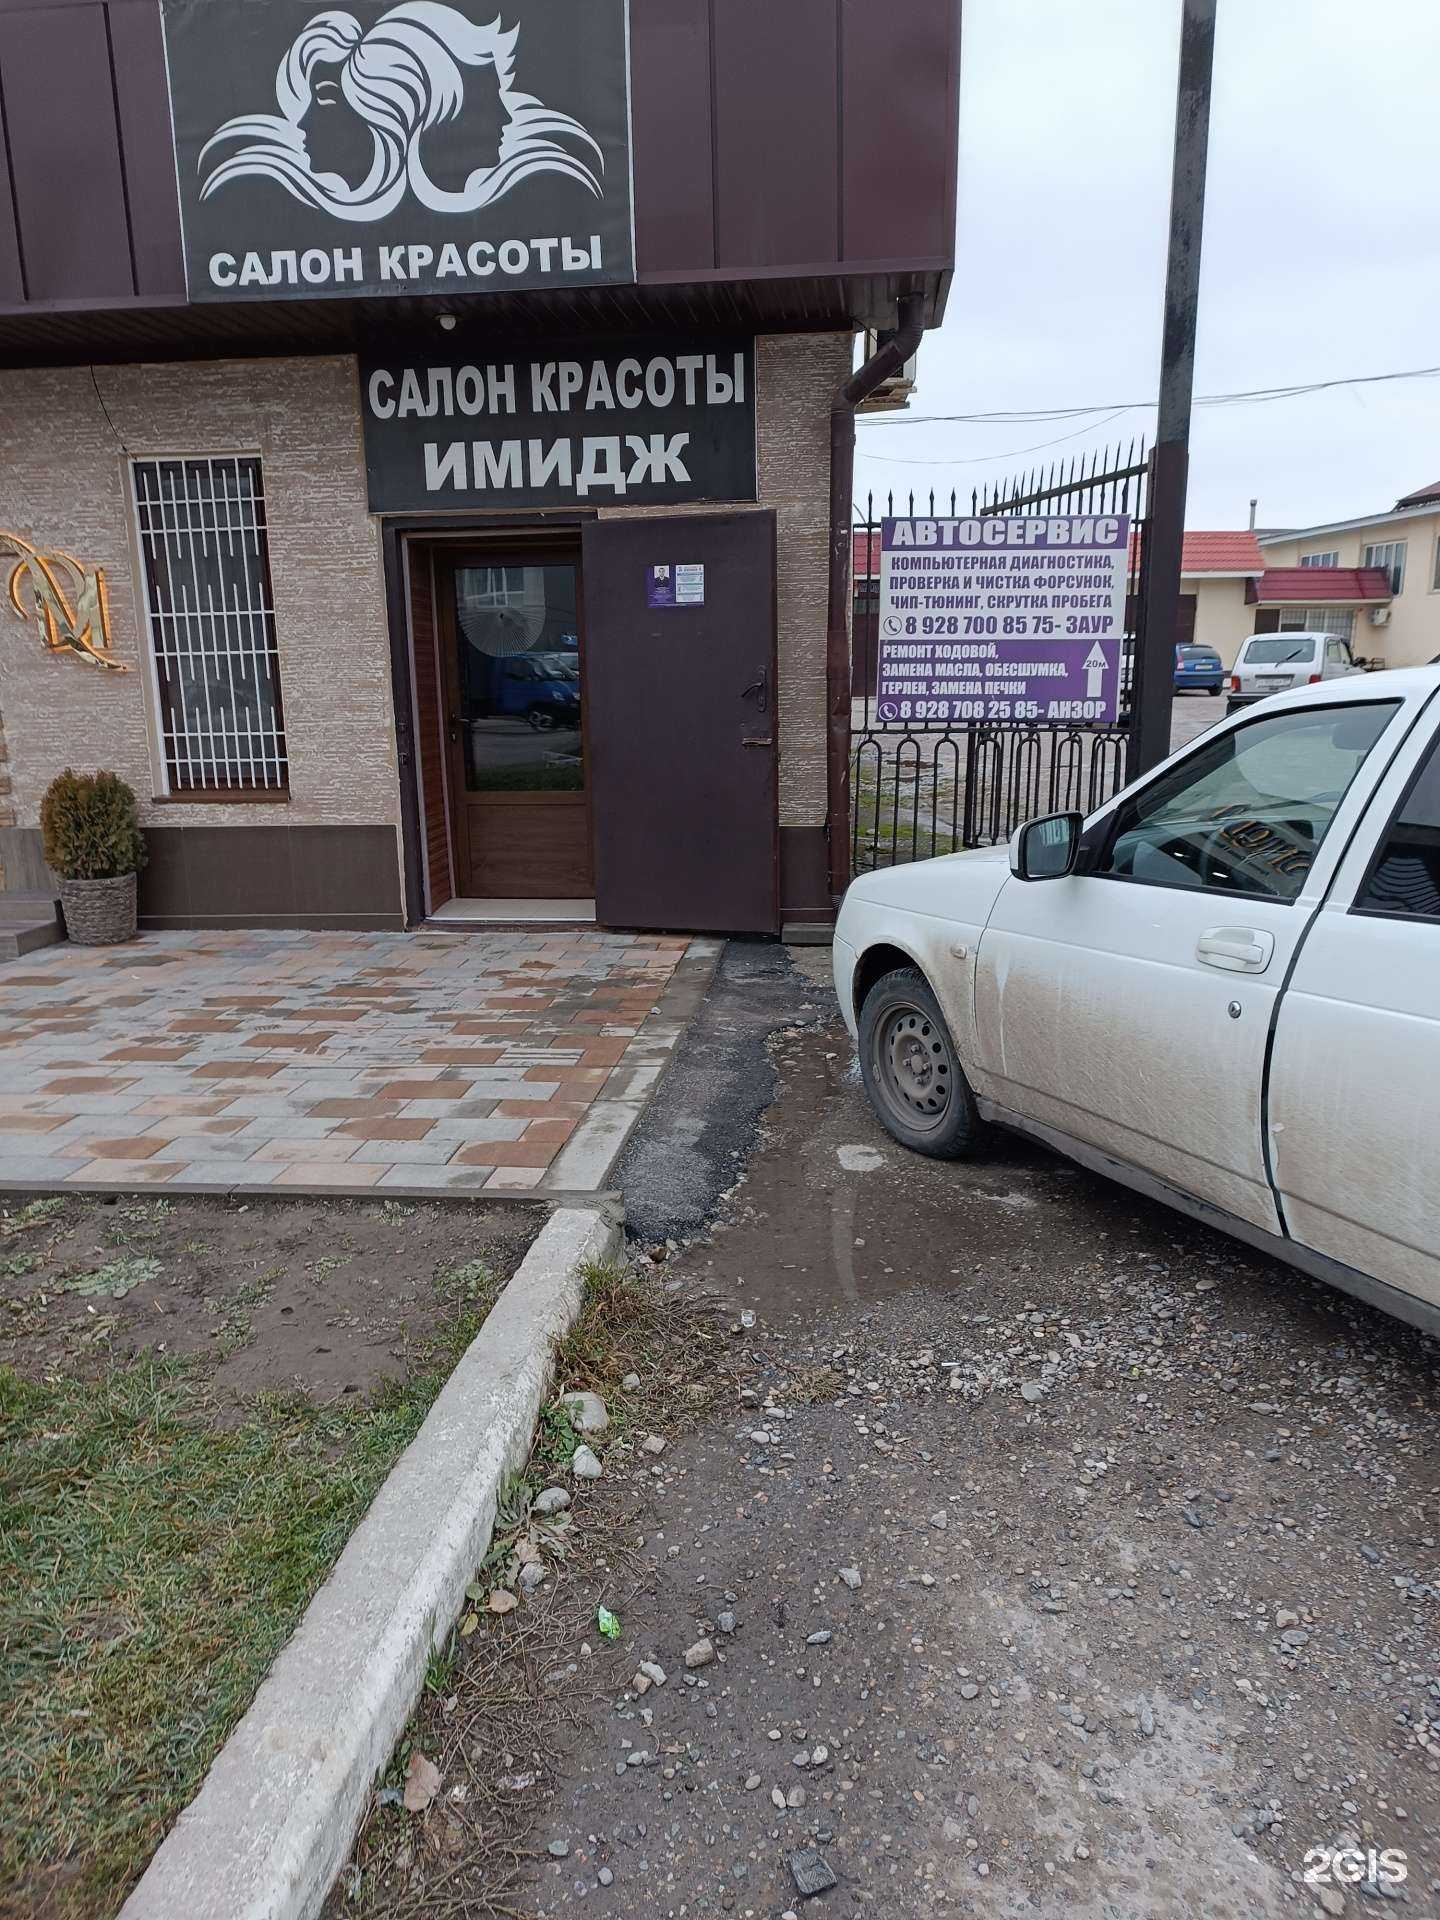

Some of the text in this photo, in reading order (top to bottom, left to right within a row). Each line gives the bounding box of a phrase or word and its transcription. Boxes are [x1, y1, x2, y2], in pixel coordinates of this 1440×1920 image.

[208, 234, 603, 288] САЛОН КРАСОТЫ
[368, 352, 745, 420] САЛОН КРАСОТЫ
[423, 432, 692, 497] ИМИДЖ
[891, 517, 1119, 546] АВТОСЕРВИС
[891, 555, 1115, 572] КОМПЬЮТЕРНАЯ ДИАГНОСТИКА,
[889, 574, 1115, 590] ПРОВЕРКА И ЧИСТКА ФОРСУНОК,
[890, 594, 1112, 610] ЧИП-ТЮНИНГ, СКРУТКА ПРОБЕГА
[905, 615, 917, 635] 8
[922, 615, 959, 635] 928
[963, 615, 998, 635] 700
[1002, 615, 1028, 634] 85
[1065, 614, 1114, 634] ЗАУР
[882, 641, 999, 660] РЕМОНТ ХОДОВОЙ,
[882, 662, 1069, 678] ЗАМЕНА МАСЛА, ОБЕСШУМКА,
[931, 681, 983, 695] ЗАМЕНА
[984, 681, 1027, 695] ПЕЧКИ
[900, 700, 911, 719] 8
[915, 700, 949, 719] 928
[952, 700, 985, 719] 708
[987, 700, 1011, 719] 25
